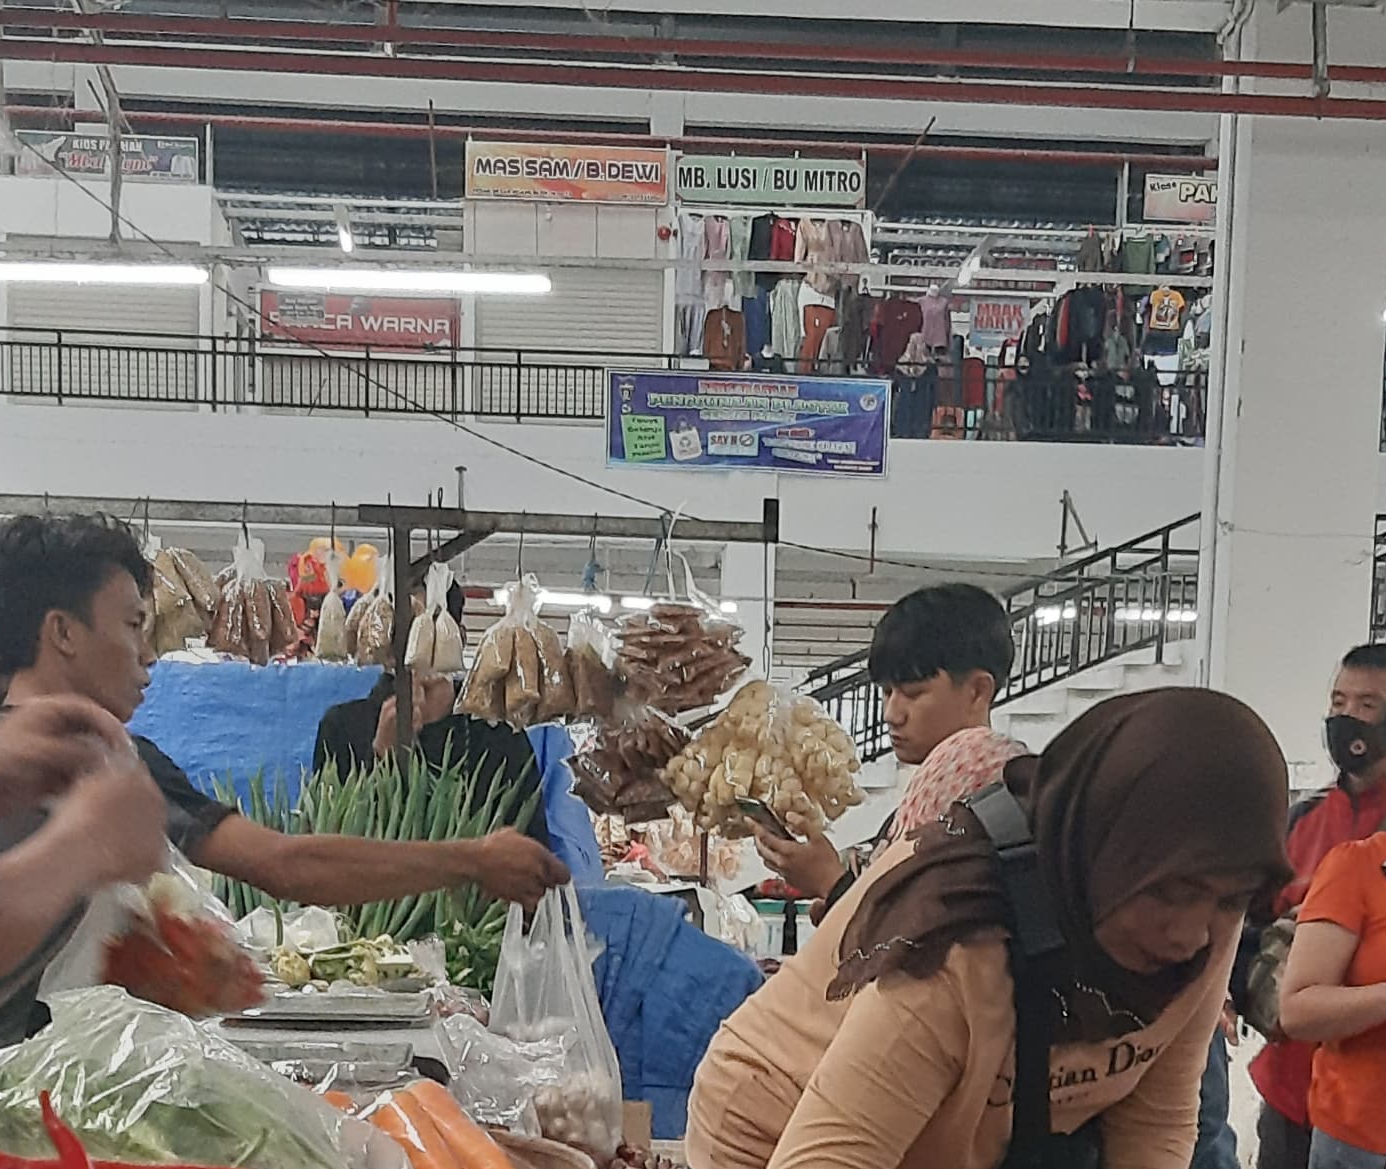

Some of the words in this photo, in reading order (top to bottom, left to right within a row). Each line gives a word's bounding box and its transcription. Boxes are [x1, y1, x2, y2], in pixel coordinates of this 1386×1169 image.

[474, 157, 520, 176] MAS
[524, 159, 570, 178] SAM
[678, 167, 710, 189] MB.
[716, 167, 758, 189] LUSI
[762, 167, 769, 190] /
[773, 169, 798, 191] BU
[804, 170, 862, 193] MITRO
[360, 315, 451, 335] WARNA
